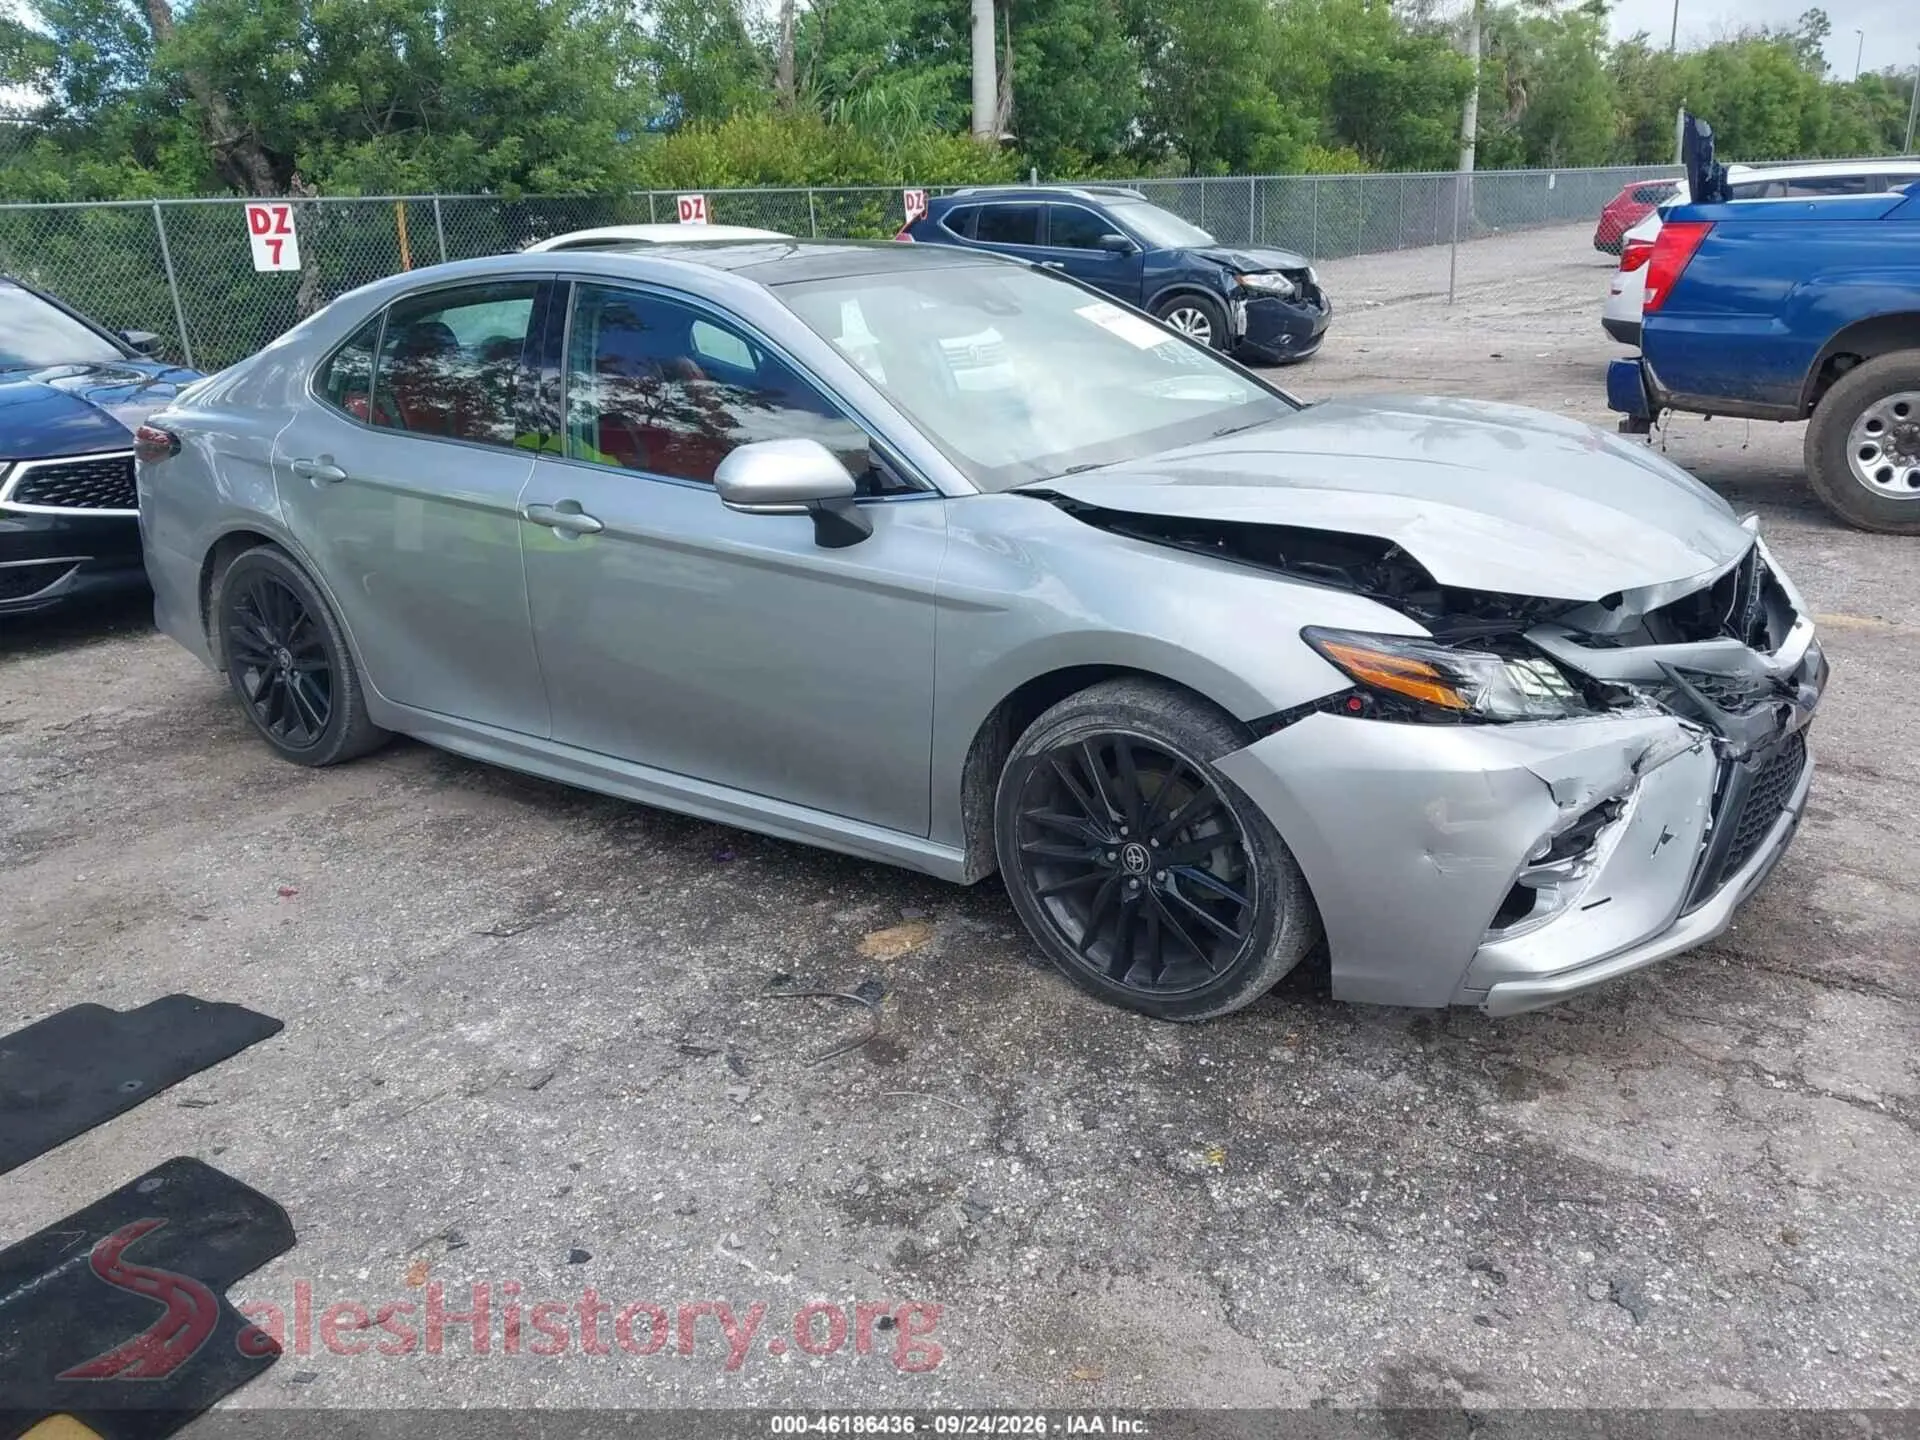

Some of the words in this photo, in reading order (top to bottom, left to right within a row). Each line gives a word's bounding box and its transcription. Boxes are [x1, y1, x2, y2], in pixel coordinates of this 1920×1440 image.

[680, 199, 703, 220] DZ
[906, 193, 924, 211] DZ
[249, 207, 292, 235] DZ
[265, 239, 283, 265] 7
